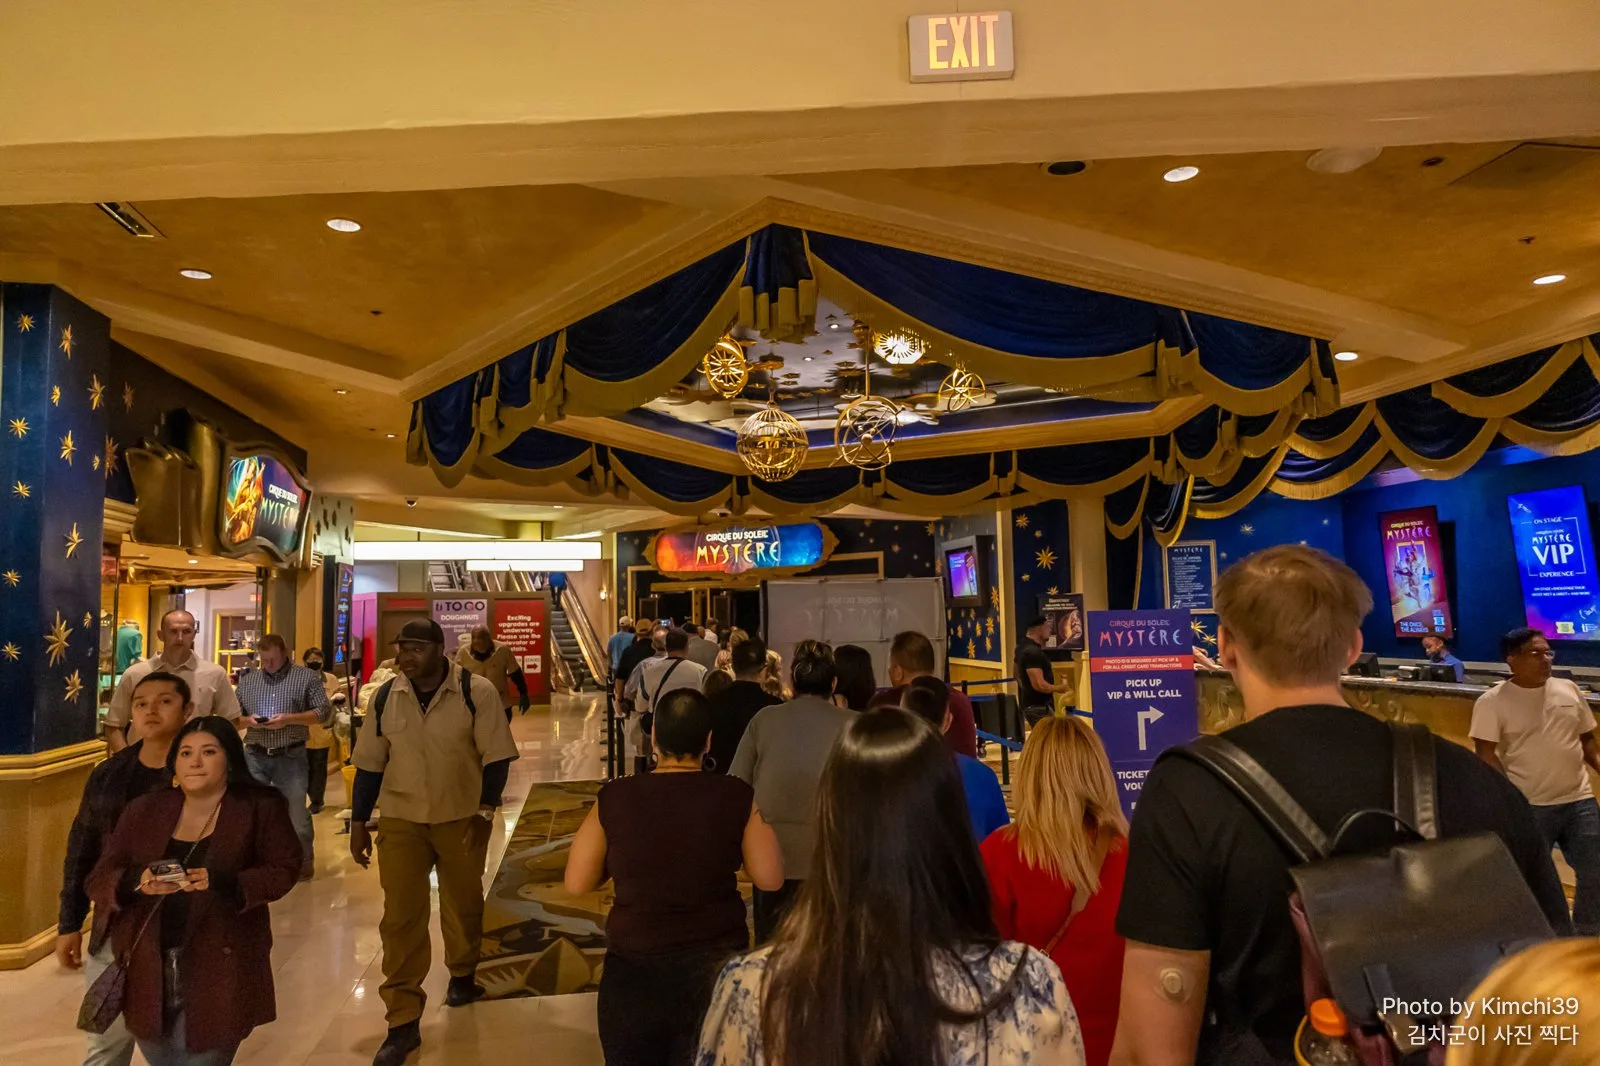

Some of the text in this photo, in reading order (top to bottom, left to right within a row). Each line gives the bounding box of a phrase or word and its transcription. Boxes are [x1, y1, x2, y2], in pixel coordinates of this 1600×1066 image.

[928, 15, 998, 69] EXIT
[706, 530, 769, 543] CIRQUE DU SOLEIL
[1387, 526, 1432, 540] MYSTÈRE
[696, 539, 779, 565] MYSTÈRE
[1532, 543, 1575, 565] VIP
[445, 601, 462, 611] TO
[464, 601, 485, 611] GO
[1109, 620, 1135, 629] CIRQUE
[1099, 627, 1184, 647] MYSTÈRE
[1126, 679, 1162, 688] PICK UP
[1107, 689, 1182, 700] VIP & WILL CALL
